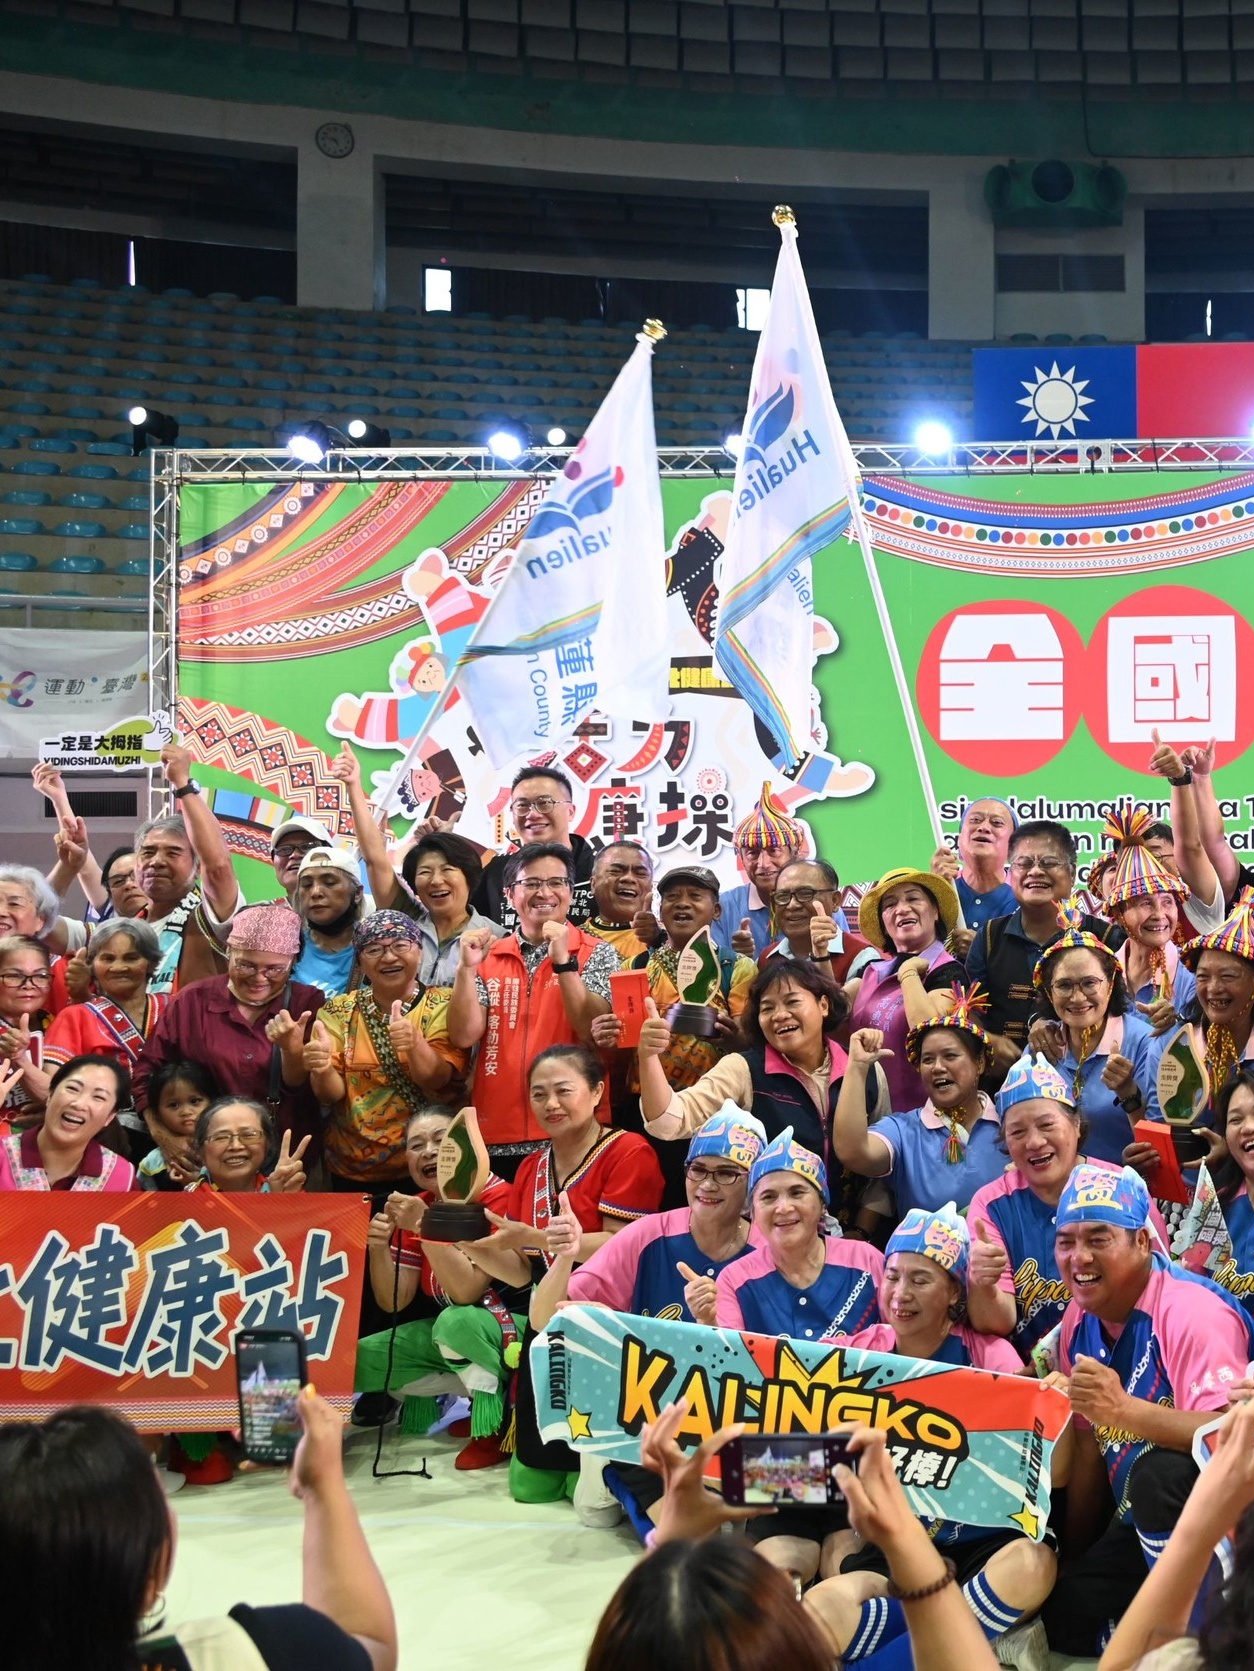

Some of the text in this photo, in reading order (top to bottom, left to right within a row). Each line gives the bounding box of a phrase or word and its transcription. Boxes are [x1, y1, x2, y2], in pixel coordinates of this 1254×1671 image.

[45, 679, 85, 695] 運動
[530, 669, 551, 737] County
[45, 735, 142, 751] 一定是大拇指
[0, 1220, 348, 1376] 健康站
[623, 1341, 962, 1450] KALINGKO
